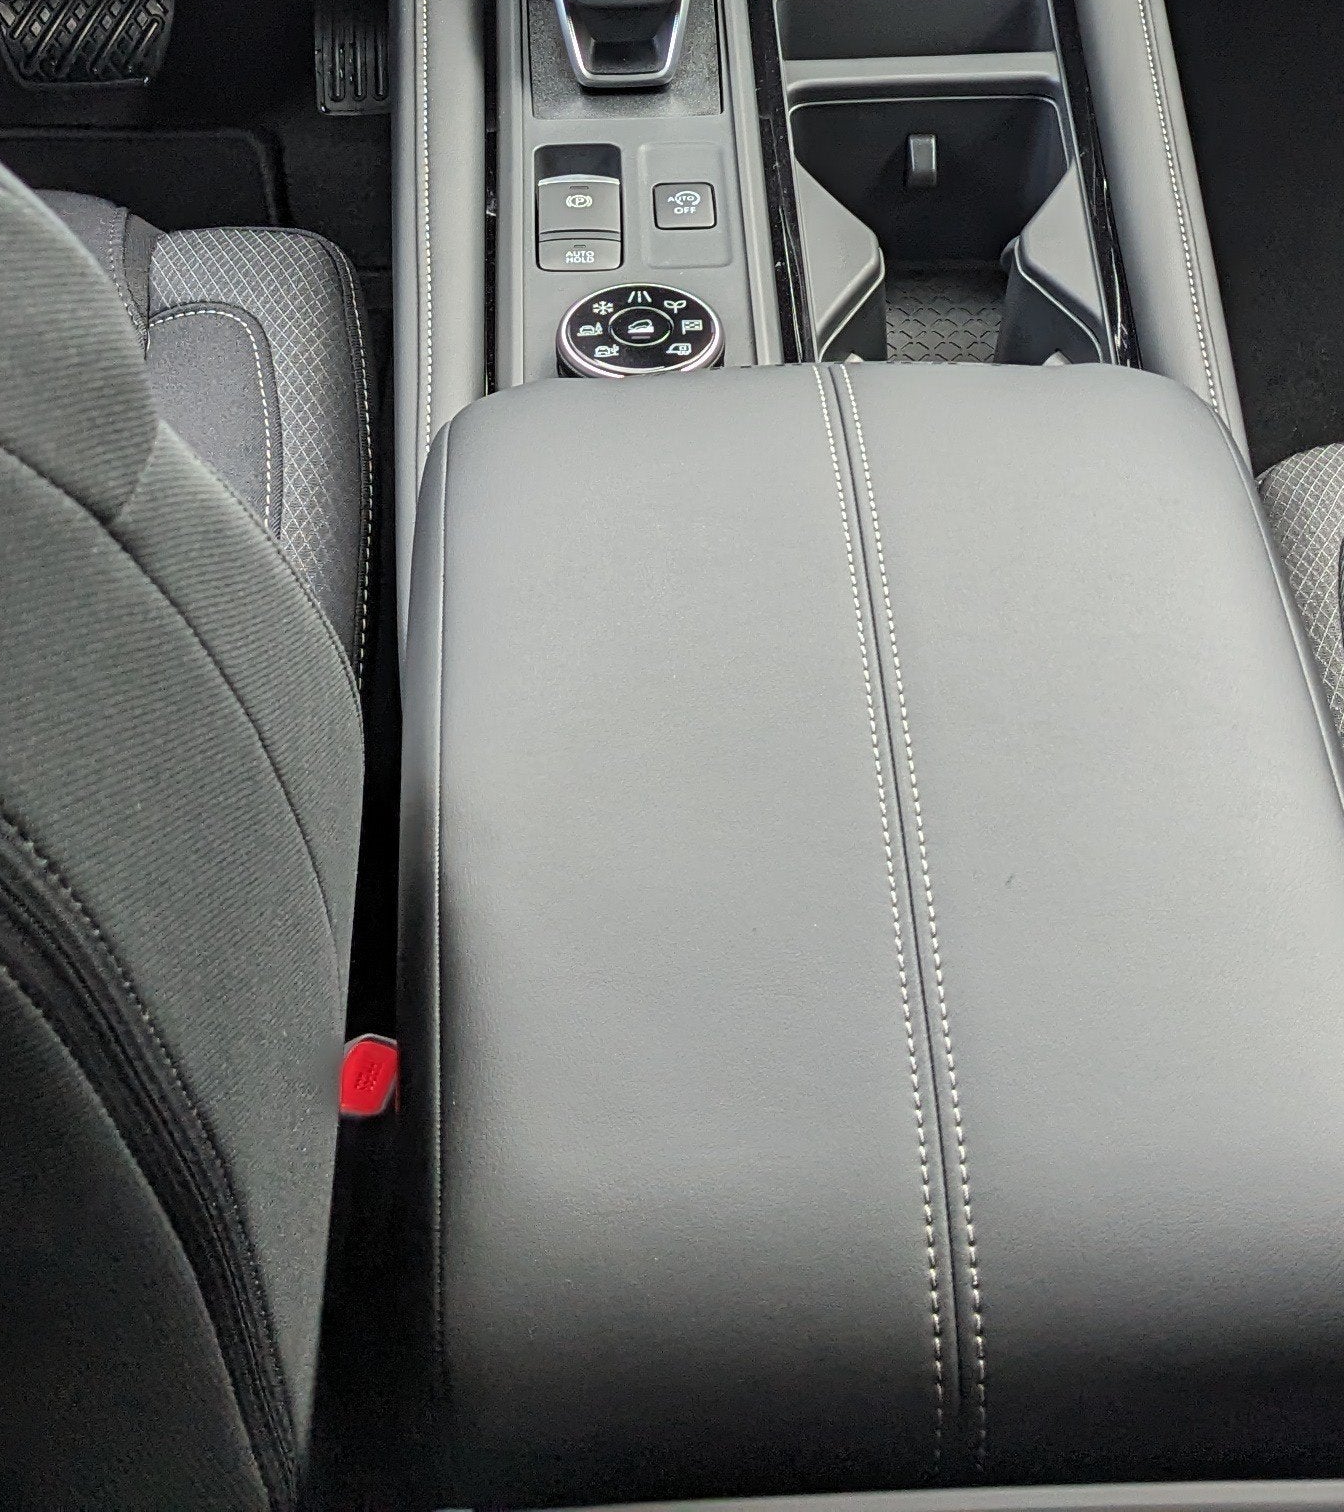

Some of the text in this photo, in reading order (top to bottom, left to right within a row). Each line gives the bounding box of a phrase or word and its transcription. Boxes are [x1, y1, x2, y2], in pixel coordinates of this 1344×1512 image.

[673, 206, 696, 214] OFF
[565, 250, 595, 258] AUTO
[565, 256, 595, 264] HOLD
